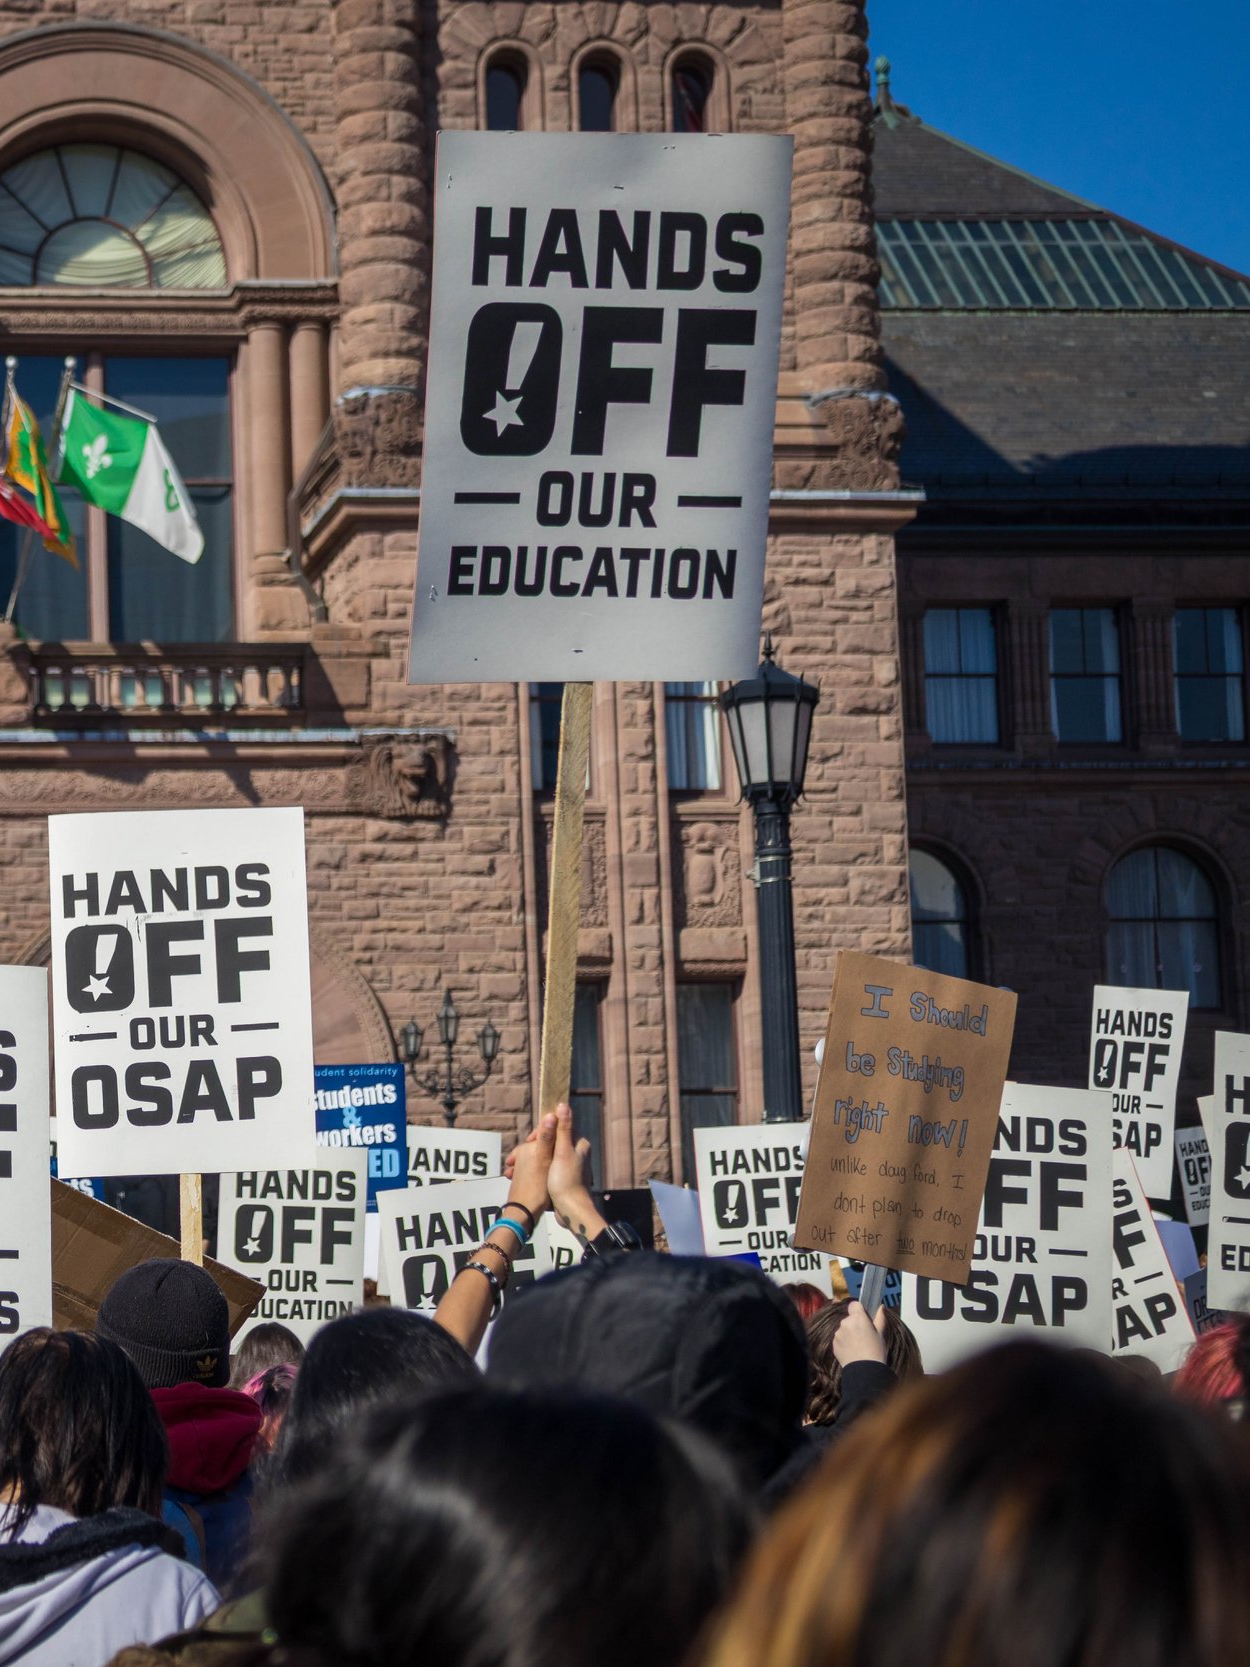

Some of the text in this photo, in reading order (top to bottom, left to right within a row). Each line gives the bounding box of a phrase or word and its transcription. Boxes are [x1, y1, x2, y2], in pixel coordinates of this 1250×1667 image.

[472, 207, 764, 293] HANDS
[460, 302, 757, 457] OFF
[536, 471, 657, 528] OUR
[447, 545, 738, 600] EDUCATION
[62, 863, 272, 918] HANDS
[65, 916, 274, 1013] OFF
[129, 1014, 218, 1050] OUR
[861, 984, 988, 1036] I Should
[1096, 1009, 1173, 1039] HANDS
[349, 1067, 398, 1078] solidarity
[846, 1041, 964, 1102] be Studying
[1093, 1038, 1170, 1092] OFF
[71, 1056, 282, 1130] OSAP
[343, 1105, 362, 1128] &
[316, 1123, 398, 1148] workers
[834, 1096, 968, 1157] right now!
[236, 1171, 356, 1202] HANDS
[952, 1174, 965, 1189] I
[234, 1204, 356, 1265] OFF
[812, 1225, 836, 1241] out
[847, 1227, 883, 1246] after
[873, 1196, 902, 1219] plan
[911, 1202, 924, 1219] to
[934, 1206, 961, 1228] drop
[748, 1230, 789, 1250] OUR
[268, 1269, 318, 1292] OUR
[916, 1270, 1088, 1327] OSAP
